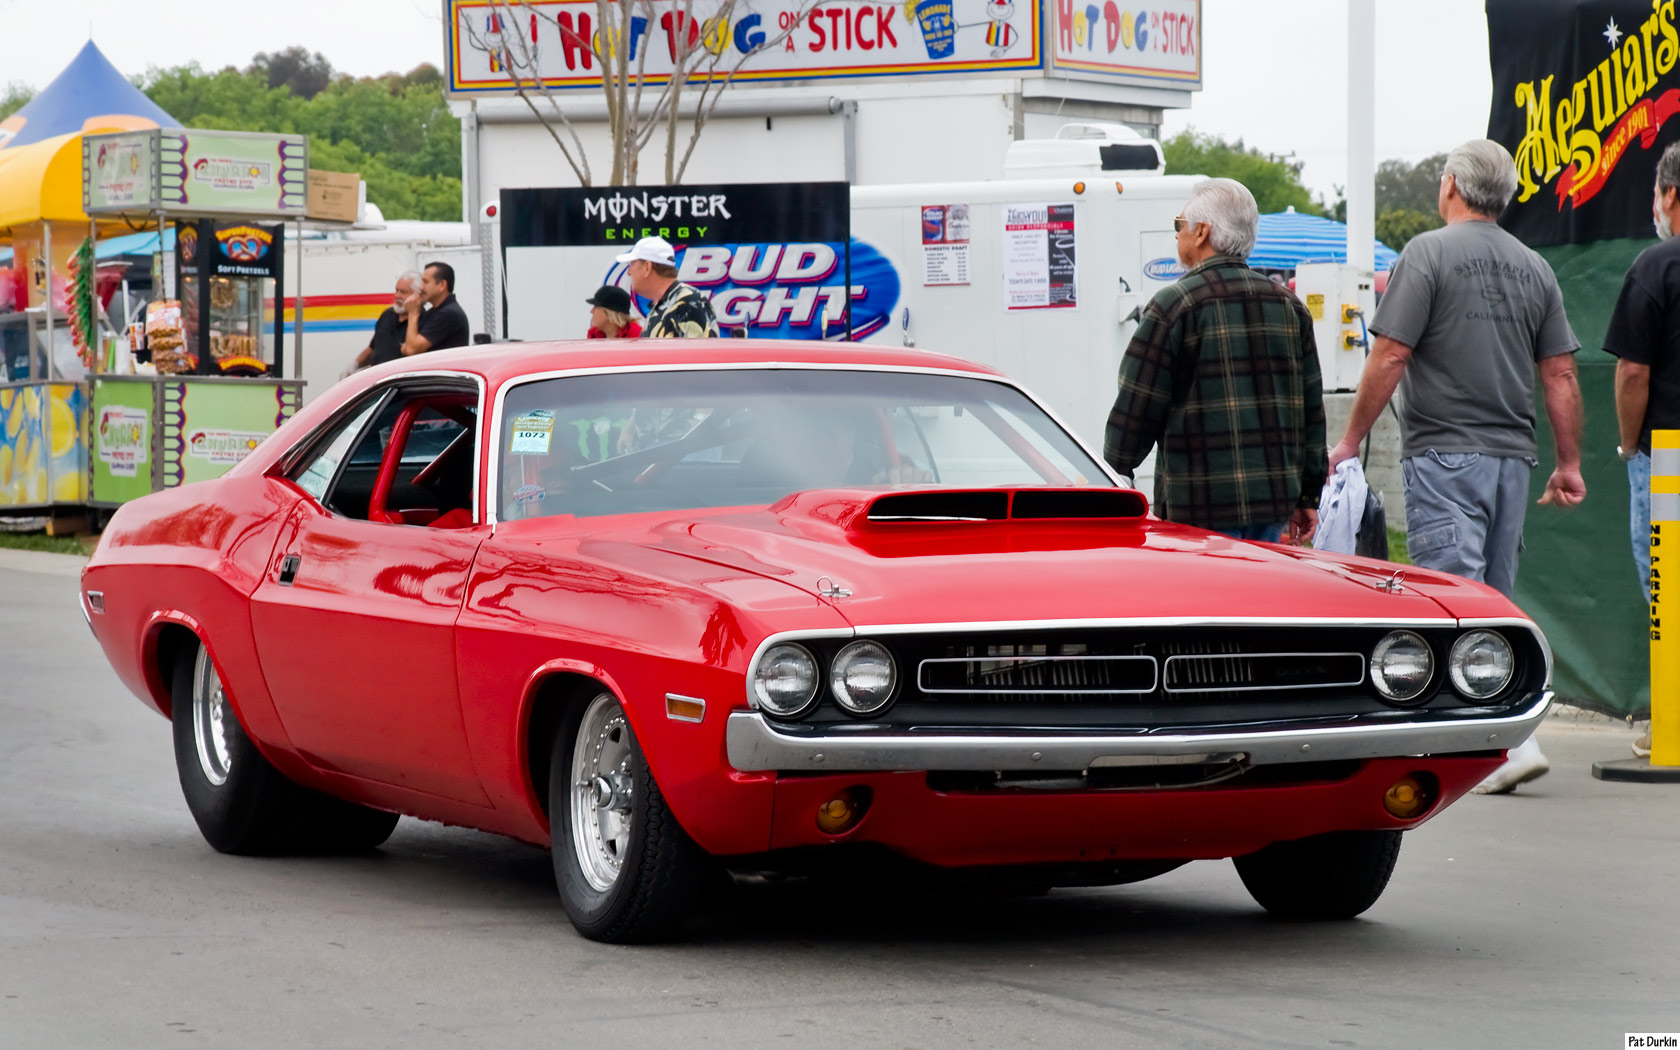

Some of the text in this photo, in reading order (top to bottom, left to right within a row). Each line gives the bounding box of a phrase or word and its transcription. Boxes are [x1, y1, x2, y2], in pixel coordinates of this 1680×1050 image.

[779, 11, 800, 30] ON
[808, 6, 898, 53] STICK
[1058, 0, 1100, 54] HOT
[1104, 0, 1148, 54] DOG
[1152, 11, 1160, 29] ON
[1162, 11, 1195, 56] STICK
[660, 10, 766, 64] DOG
[785, 35, 795, 53] A
[1601, 105, 1649, 177] since 1901
[584, 191, 731, 223] MONSTER
[605, 226, 708, 240] ENERGY
[218, 264, 270, 276] SOFT PRETZELS
[677, 242, 838, 286] BUD
[1454, 258, 1532, 285] SANTA MARIA
[1465, 311, 1519, 323] CALIORNI
[519, 431, 546, 439] 1072
[1650, 525, 1661, 641] NO PARKING
